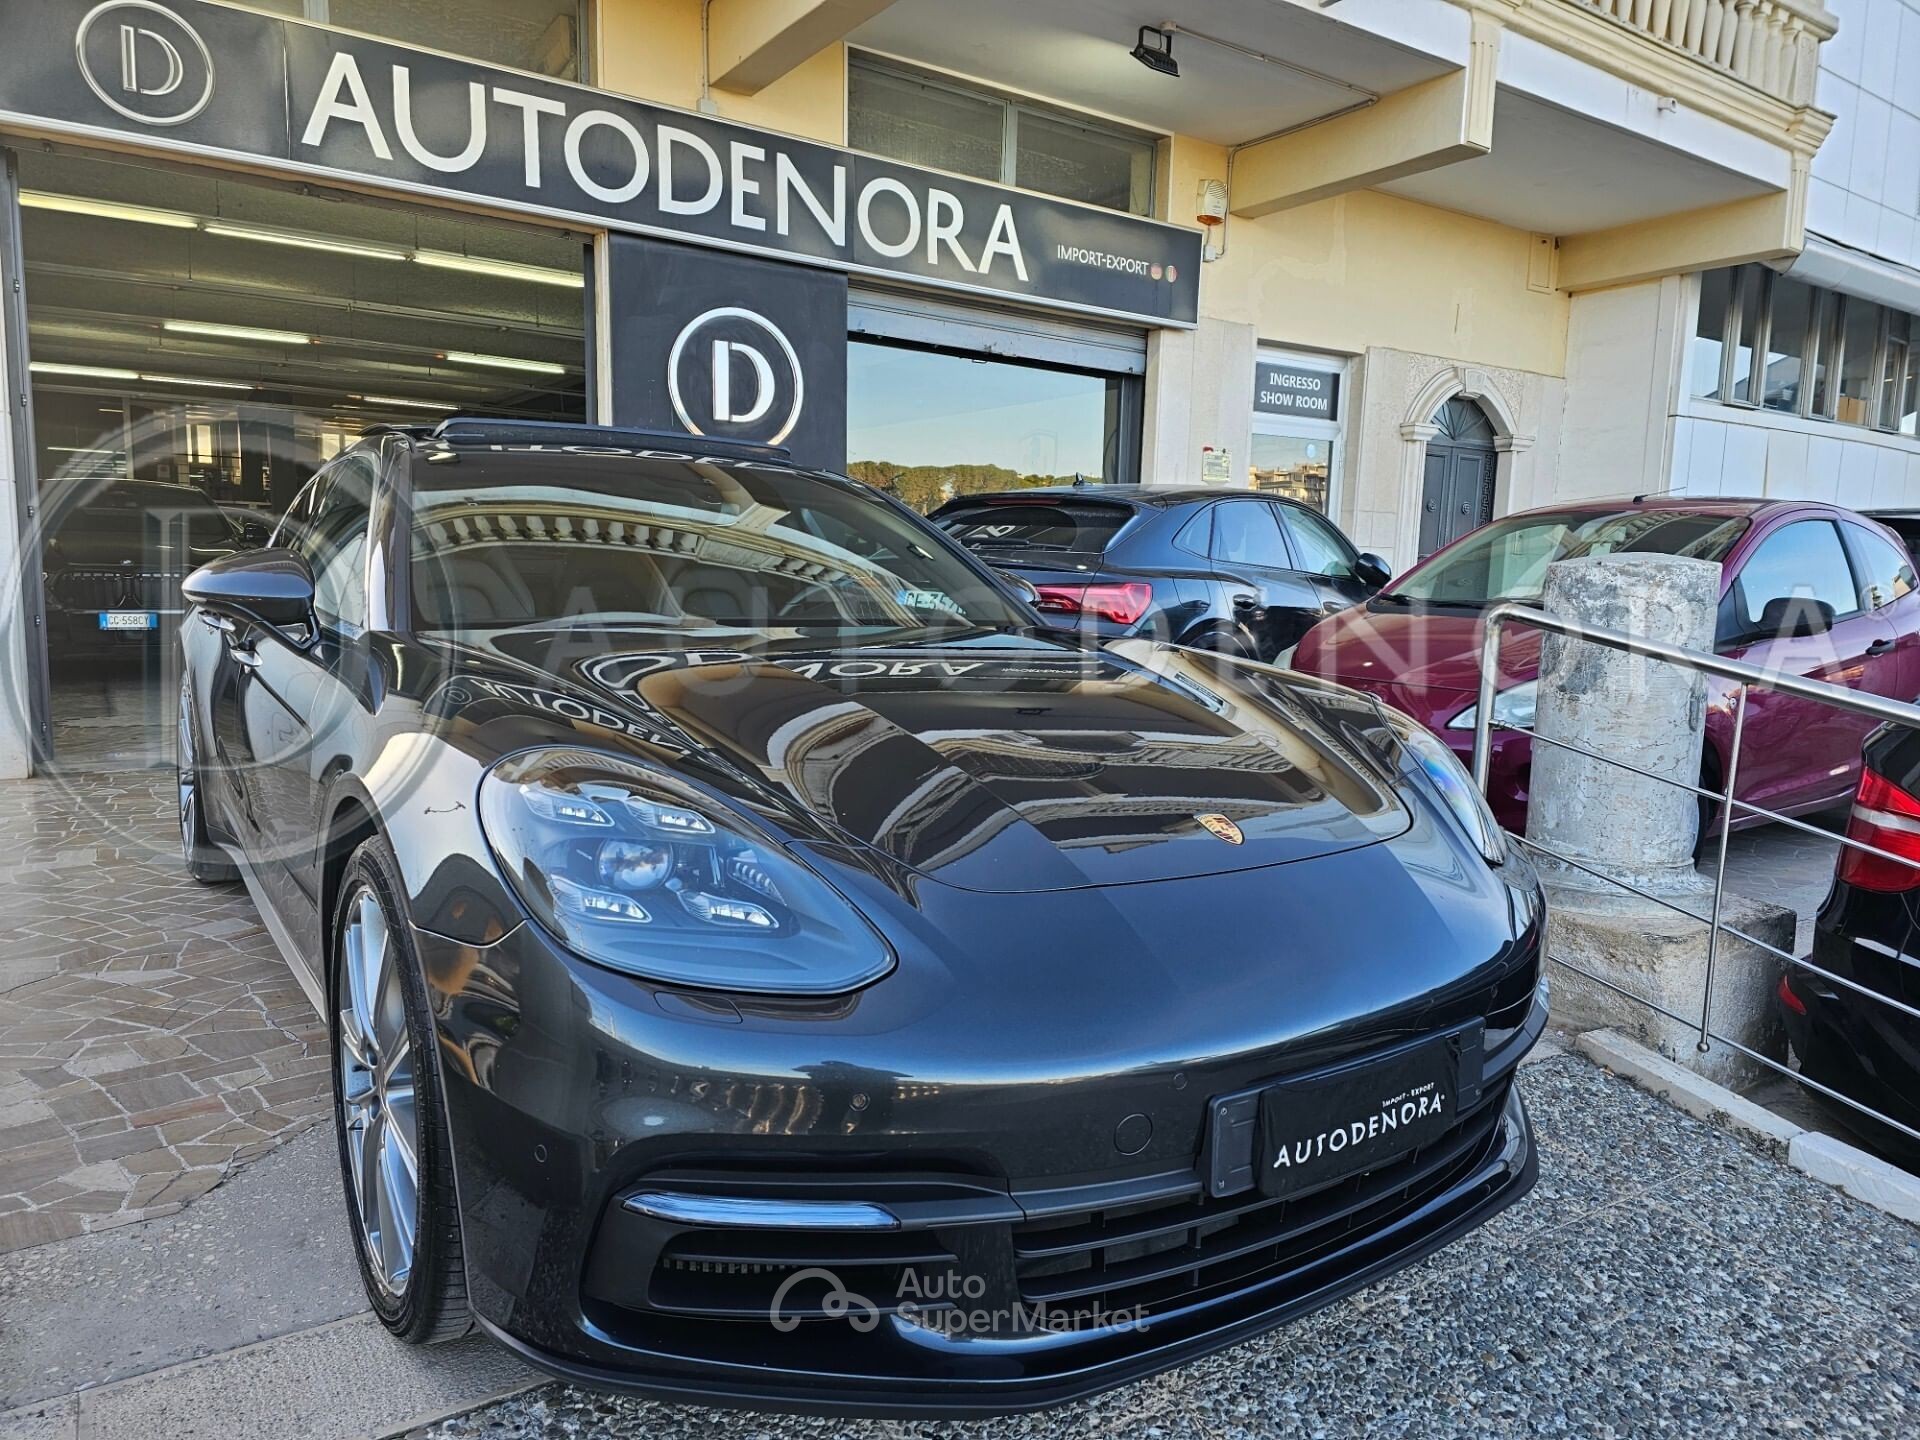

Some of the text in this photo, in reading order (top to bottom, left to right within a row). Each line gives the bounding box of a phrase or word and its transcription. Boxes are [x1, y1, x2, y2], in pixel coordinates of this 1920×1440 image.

[301, 52, 1029, 282] AUTODENORA
[1057, 244, 1149, 276] IMPORT-EXPORT
[711, 339, 776, 423] D
[1269, 372, 1321, 391] INGRESSO
[1260, 390, 1328, 411] SHOW ROOM
[1382, 1092, 1406, 1108] IMPORT
[1411, 1081, 1435, 1097] EXPORT
